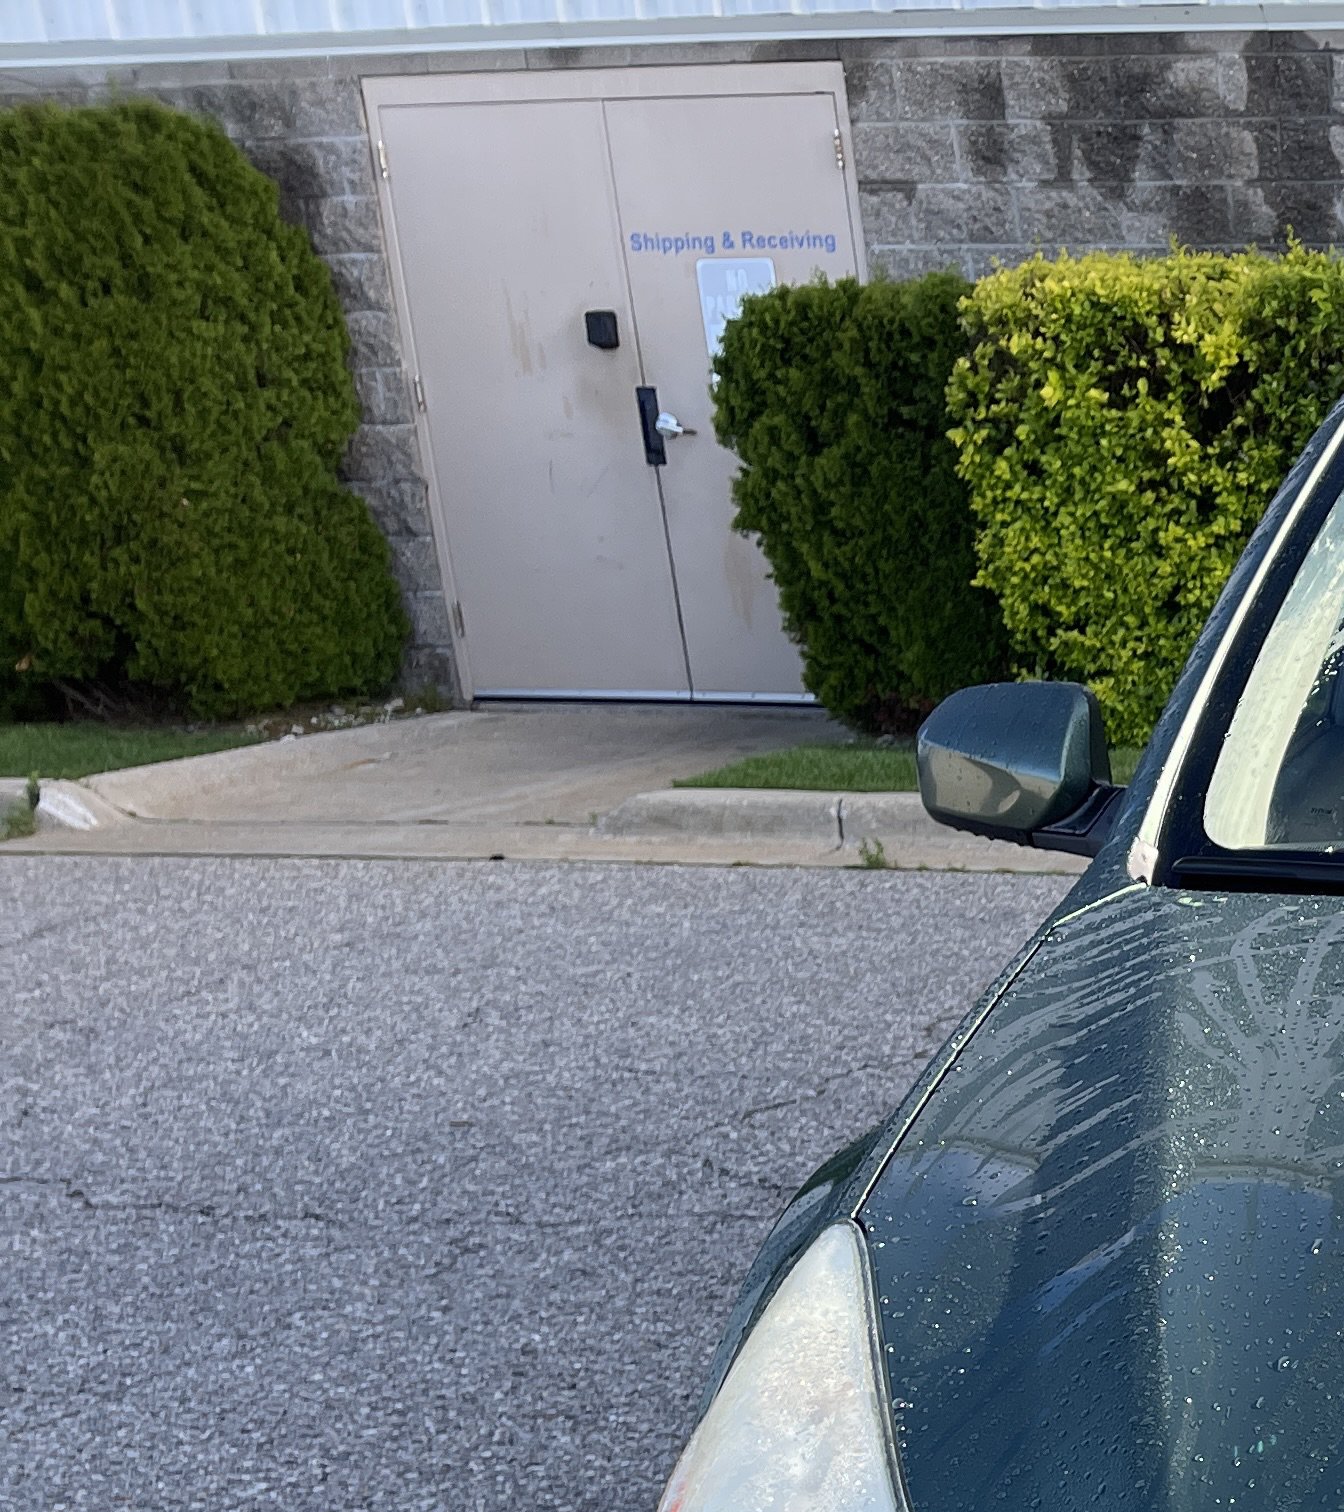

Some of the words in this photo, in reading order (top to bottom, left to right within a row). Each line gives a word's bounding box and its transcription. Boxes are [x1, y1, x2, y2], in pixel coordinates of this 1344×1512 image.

[630, 232, 715, 254] Shipping
[721, 230, 735, 249] &
[741, 230, 836, 253] Receiving
